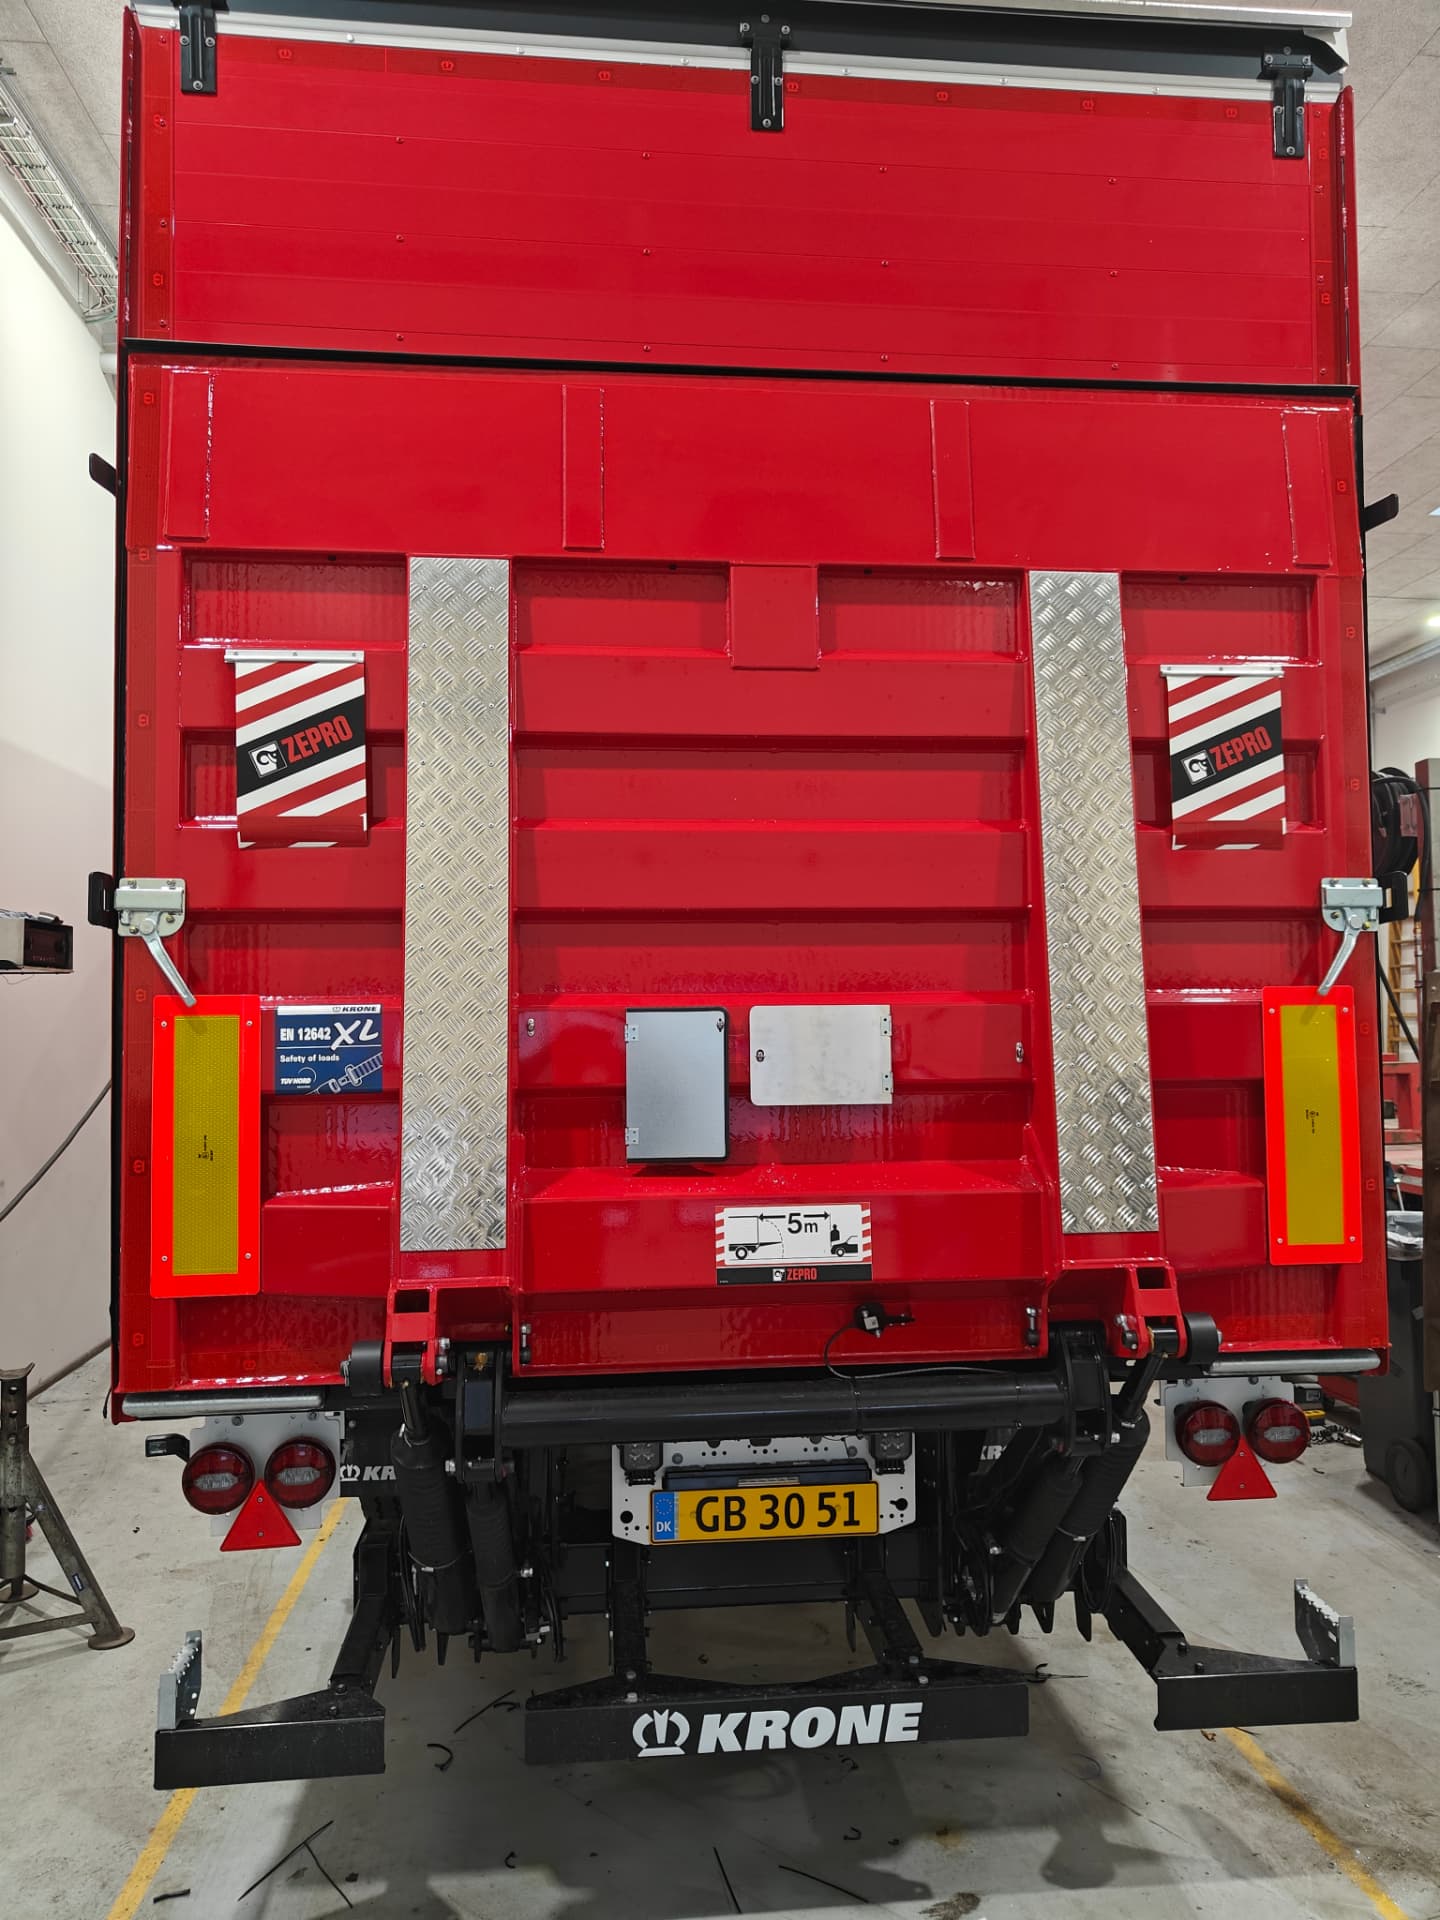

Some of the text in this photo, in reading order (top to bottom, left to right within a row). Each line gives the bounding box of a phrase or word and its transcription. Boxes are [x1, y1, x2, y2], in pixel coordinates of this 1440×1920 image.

[281, 715, 353, 763] ZEPRO
[1210, 726, 1272, 771] ZEPRO
[280, 1019, 379, 1050] EN 12642 XL
[280, 1053, 340, 1063] Safety of loads
[786, 1268, 818, 1281] ZEPRO
[656, 1520, 672, 1532] DK
[695, 1491, 861, 1533] GB 30 51
[697, 1702, 923, 1754] KRONE
